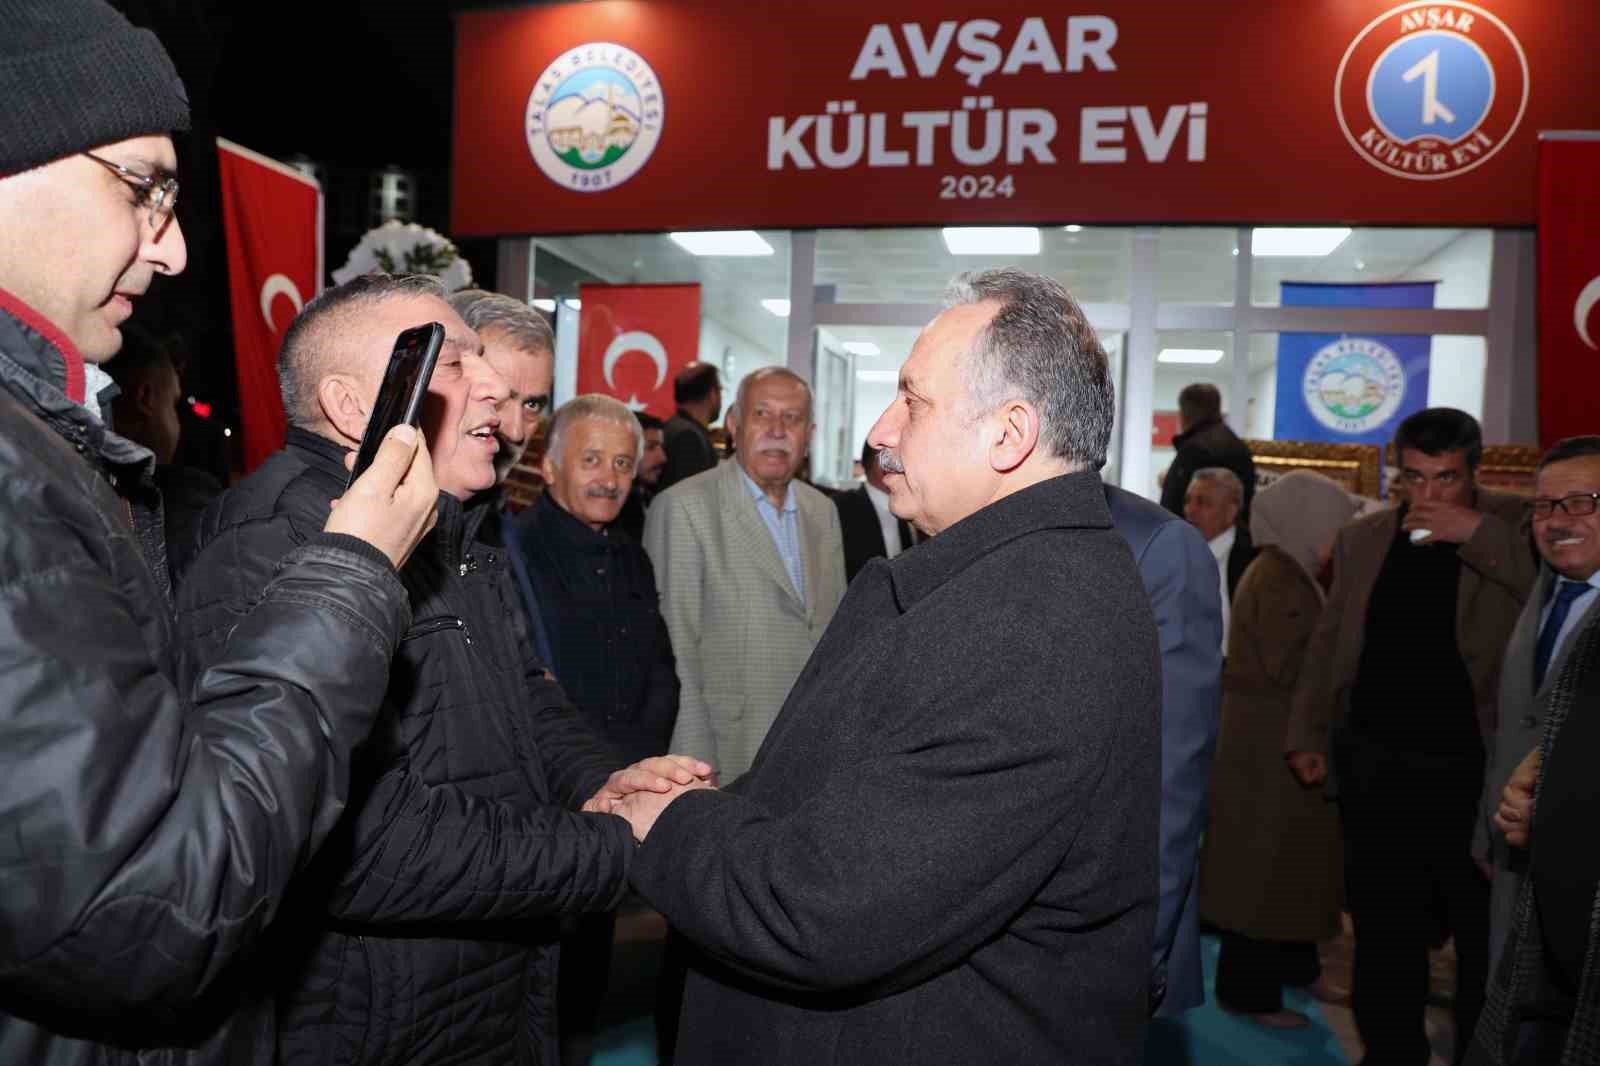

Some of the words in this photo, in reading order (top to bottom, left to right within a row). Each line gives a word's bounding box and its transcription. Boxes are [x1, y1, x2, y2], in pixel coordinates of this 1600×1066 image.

[849, 15, 1118, 87] AVŞAR
[767, 96, 1058, 170] KÜLTÜR
[940, 175, 1016, 199] 2024
